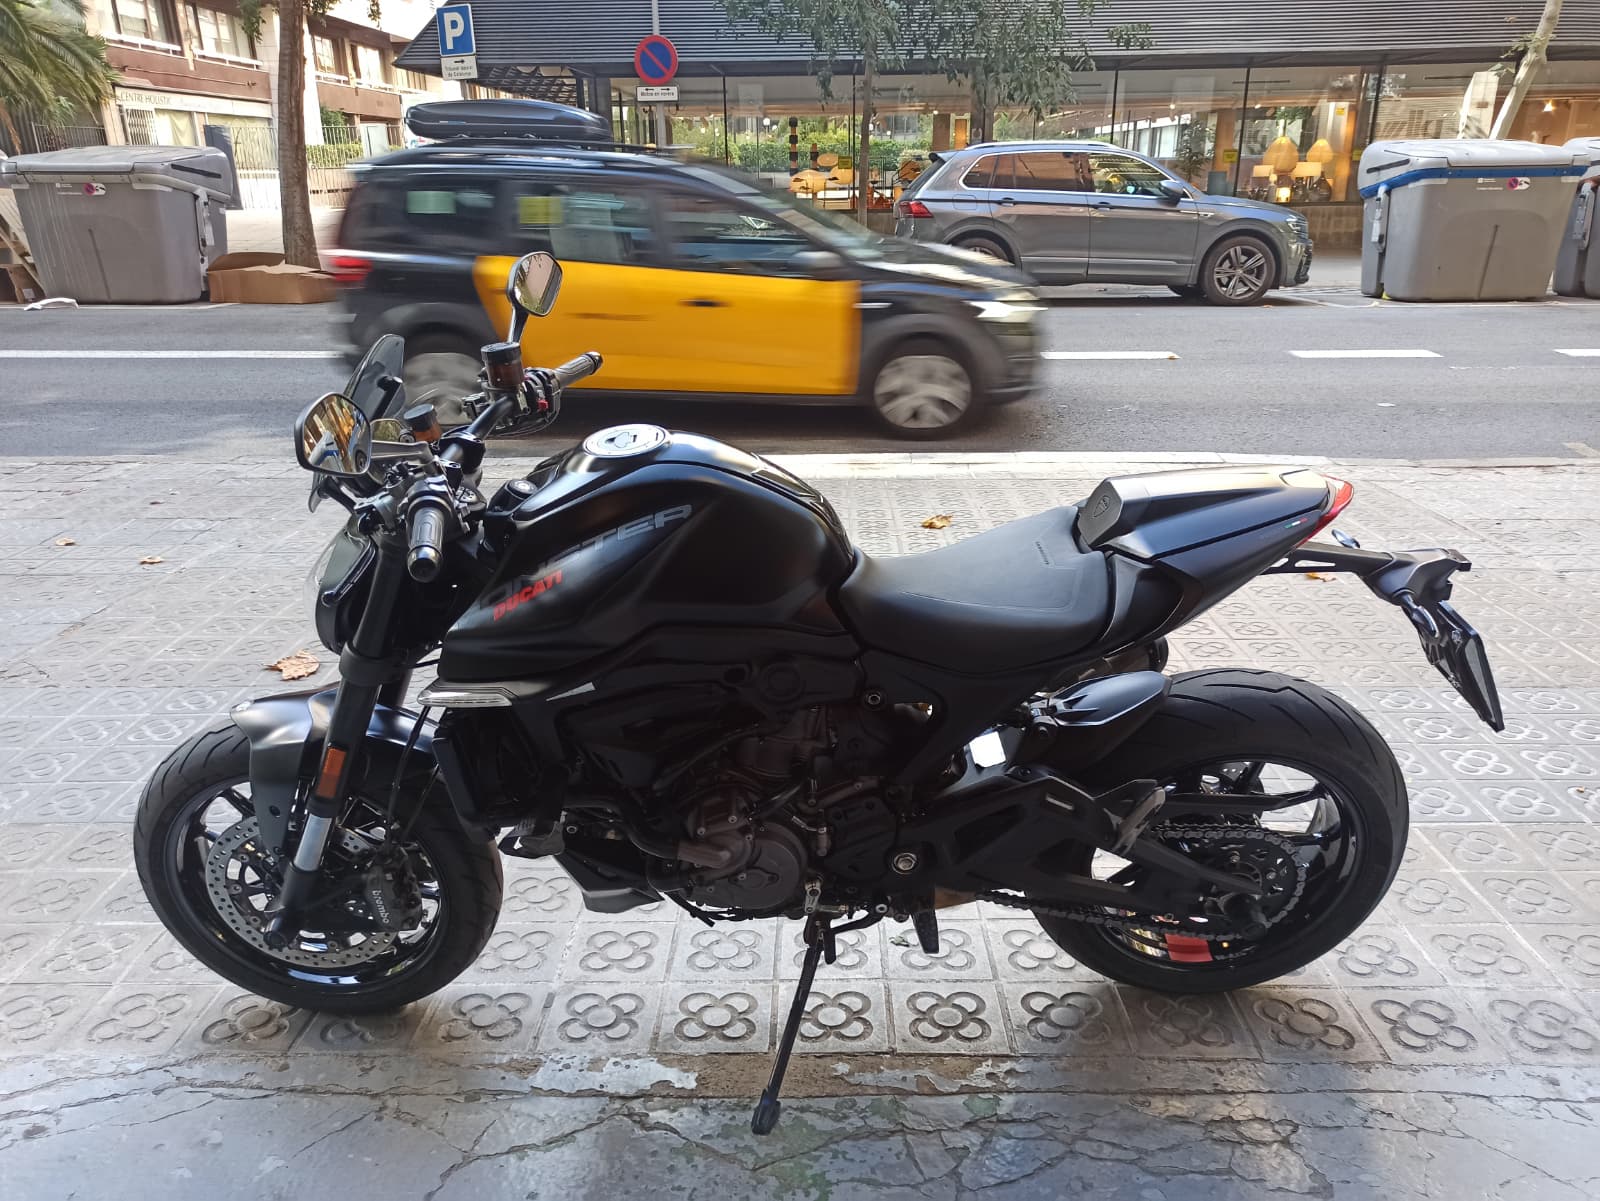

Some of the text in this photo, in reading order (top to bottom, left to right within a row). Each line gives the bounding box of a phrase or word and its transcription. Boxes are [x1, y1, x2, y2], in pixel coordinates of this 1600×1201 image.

[443, 12, 465, 50] P
[493, 568, 563, 622] DUCATI
[371, 889, 390, 924] brembo
